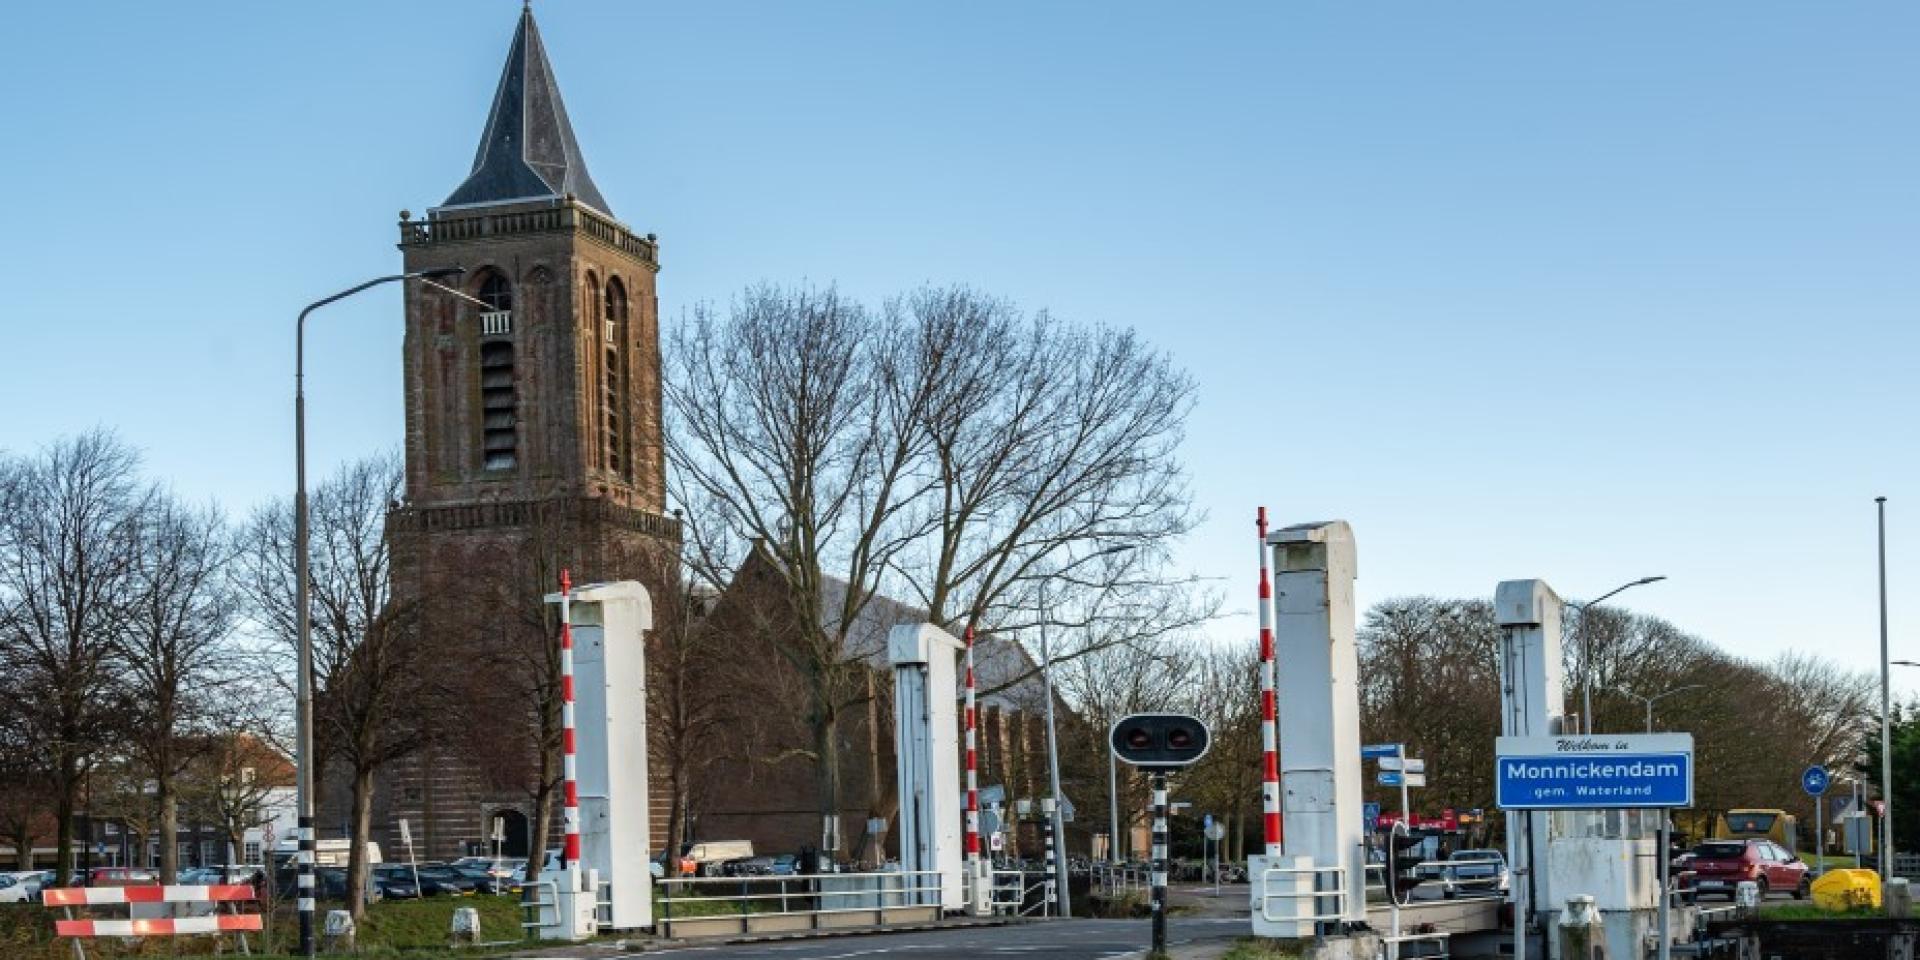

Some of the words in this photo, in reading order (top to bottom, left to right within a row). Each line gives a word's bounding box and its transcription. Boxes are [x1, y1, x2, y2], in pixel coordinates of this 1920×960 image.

[1556, 739, 1609, 752] Welkom
[1615, 740, 1629, 750] in
[1507, 762, 1679, 779] Monnickendam
[1576, 785, 1652, 796] Waterland
